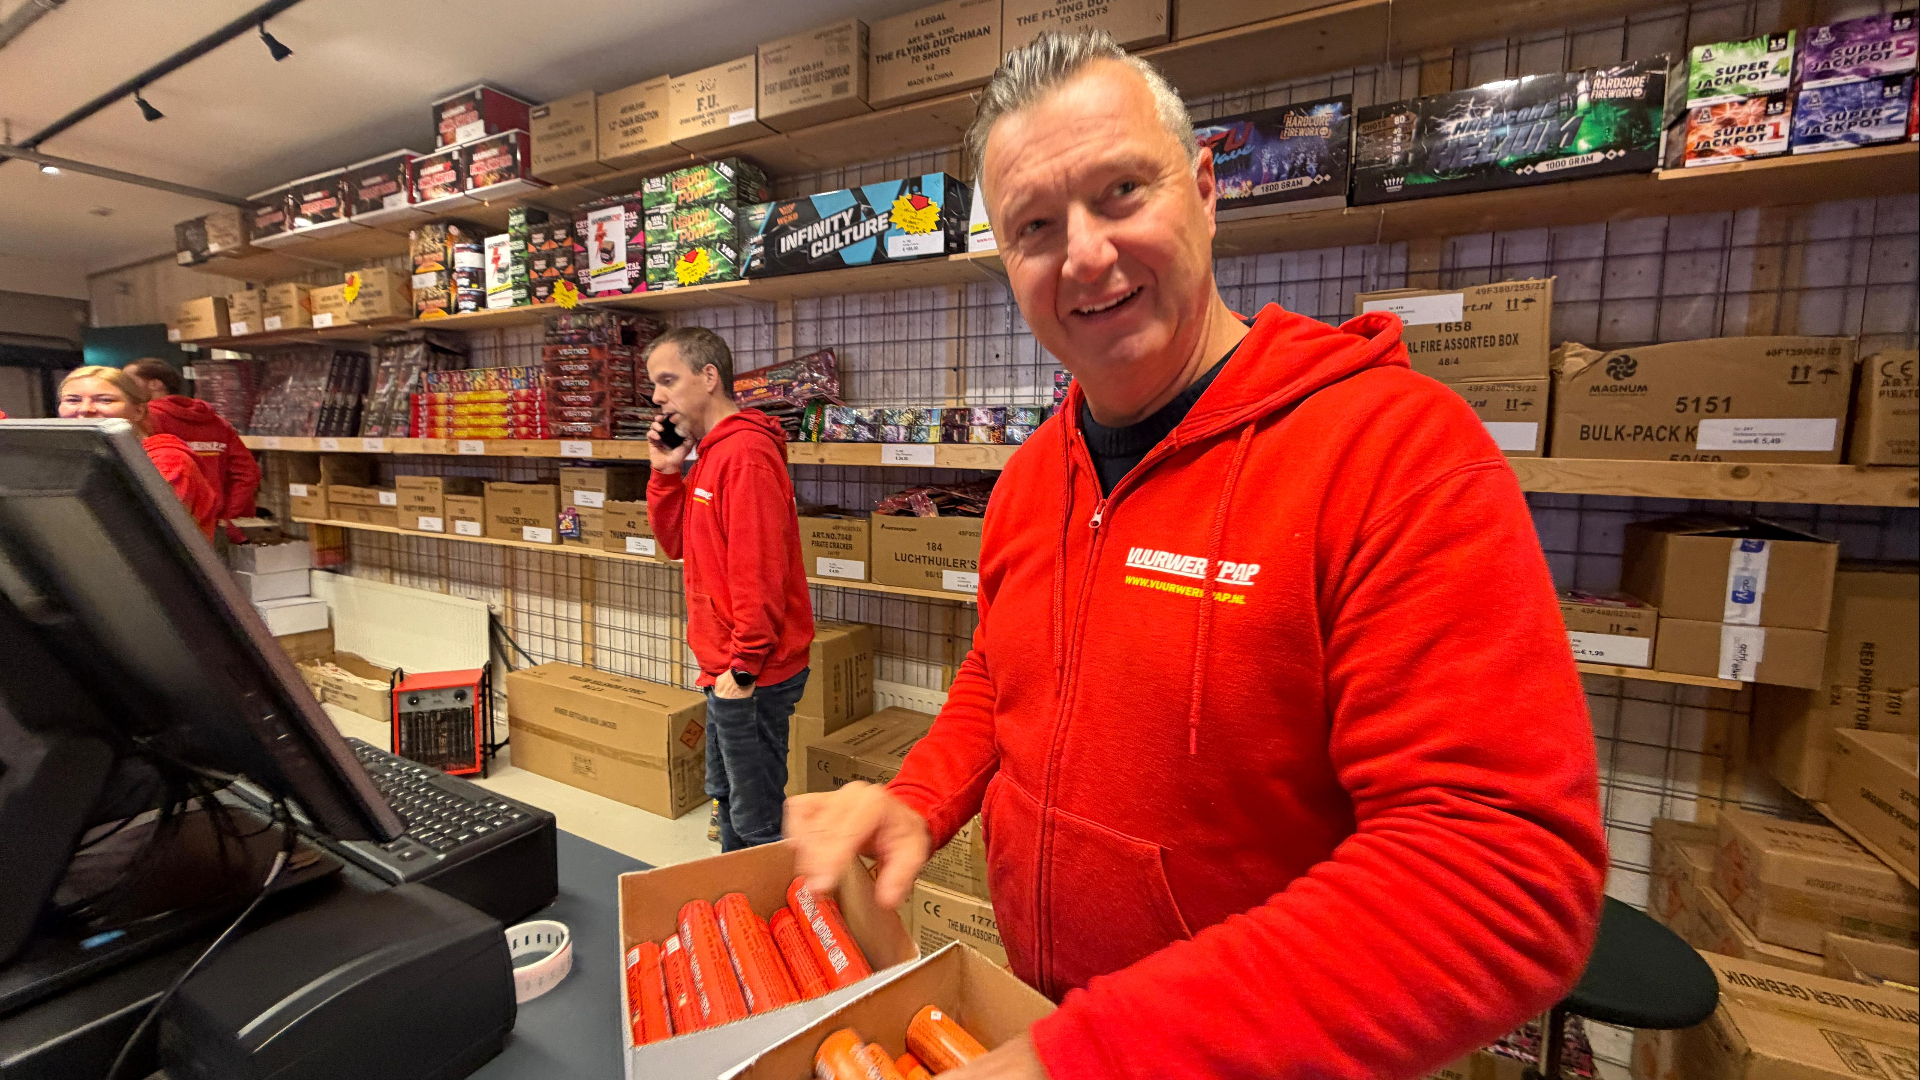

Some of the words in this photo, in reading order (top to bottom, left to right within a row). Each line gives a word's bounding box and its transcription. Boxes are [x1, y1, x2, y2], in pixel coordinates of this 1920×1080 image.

[921, 13, 946, 26] LEGAL
[1016, 13, 1039, 27] THE
[1042, 2, 1083, 20] FLYING
[1074, 6, 1108, 21] SHOTS
[1894, 17, 1911, 30] 15
[875, 52, 893, 64] THE
[896, 42, 930, 58] FLYING
[933, 26, 991, 48] DUTCHMAN
[1770, 38, 1786, 50] 15
[1833, 40, 1893, 57] SUPER
[1895, 37, 1916, 58] 5
[911, 55, 920, 63] 70
[922, 46, 951, 60] SHOTS
[1812, 51, 1892, 72] JACKPOT
[1715, 60, 1769, 77] SUPER
[1771, 56, 1791, 77] 4
[907, 79, 924, 87] MADE
[933, 70, 954, 80] CHINA
[1593, 75, 1645, 90] HARDCORE
[1696, 71, 1769, 89] JACKPOT
[1591, 87, 1632, 99] FIREWORX
[1884, 84, 1901, 97] 15
[697, 94, 719, 111] F.U.
[1768, 101, 1784, 113] 15
[1285, 113, 1331, 128] HARDCORE
[1825, 107, 1883, 123] SUPER
[1885, 105, 1906, 125] 2
[1284, 127, 1319, 137] FIREWORX
[1714, 123, 1767, 138] SUPER
[1768, 121, 1785, 140] 1
[1802, 118, 1882, 136] JACKPOT
[1694, 133, 1767, 150] JACKPOT
[1545, 158, 1566, 171] 1000
[1568, 154, 1594, 167] GRAM
[1261, 182, 1279, 193] 1800
[1281, 179, 1303, 190] GRAM
[780, 207, 855, 254] INFINITY
[811, 212, 890, 259] CULTURE
[1436, 321, 1472, 334] 1658
[1420, 339, 1441, 353] FIRE
[1444, 334, 1496, 351] ASSORTED
[1498, 333, 1519, 347] BOX
[1438, 357, 1459, 366] 48/4
[1589, 385, 1648, 393] MAGNUM
[1675, 396, 1733, 414] 5151
[1580, 424, 1680, 442] BULK-PACK
[1685, 426, 1698, 442] K
[496, 515, 520, 525] THUNDER
[626, 520, 636, 529] 42
[812, 540, 828, 548] PIRATE
[830, 542, 853, 550] CRACKER
[926, 542, 942, 551] 184
[895, 552, 977, 569] LUCHTHUILER'S
[1126, 547, 1261, 581] VUURWERPAP
[948, 918, 959, 931] THE
[959, 922, 972, 936] MAX
[970, 914, 998, 929] 1770
[1719, 968, 1809, 1000] GEBRUIK
